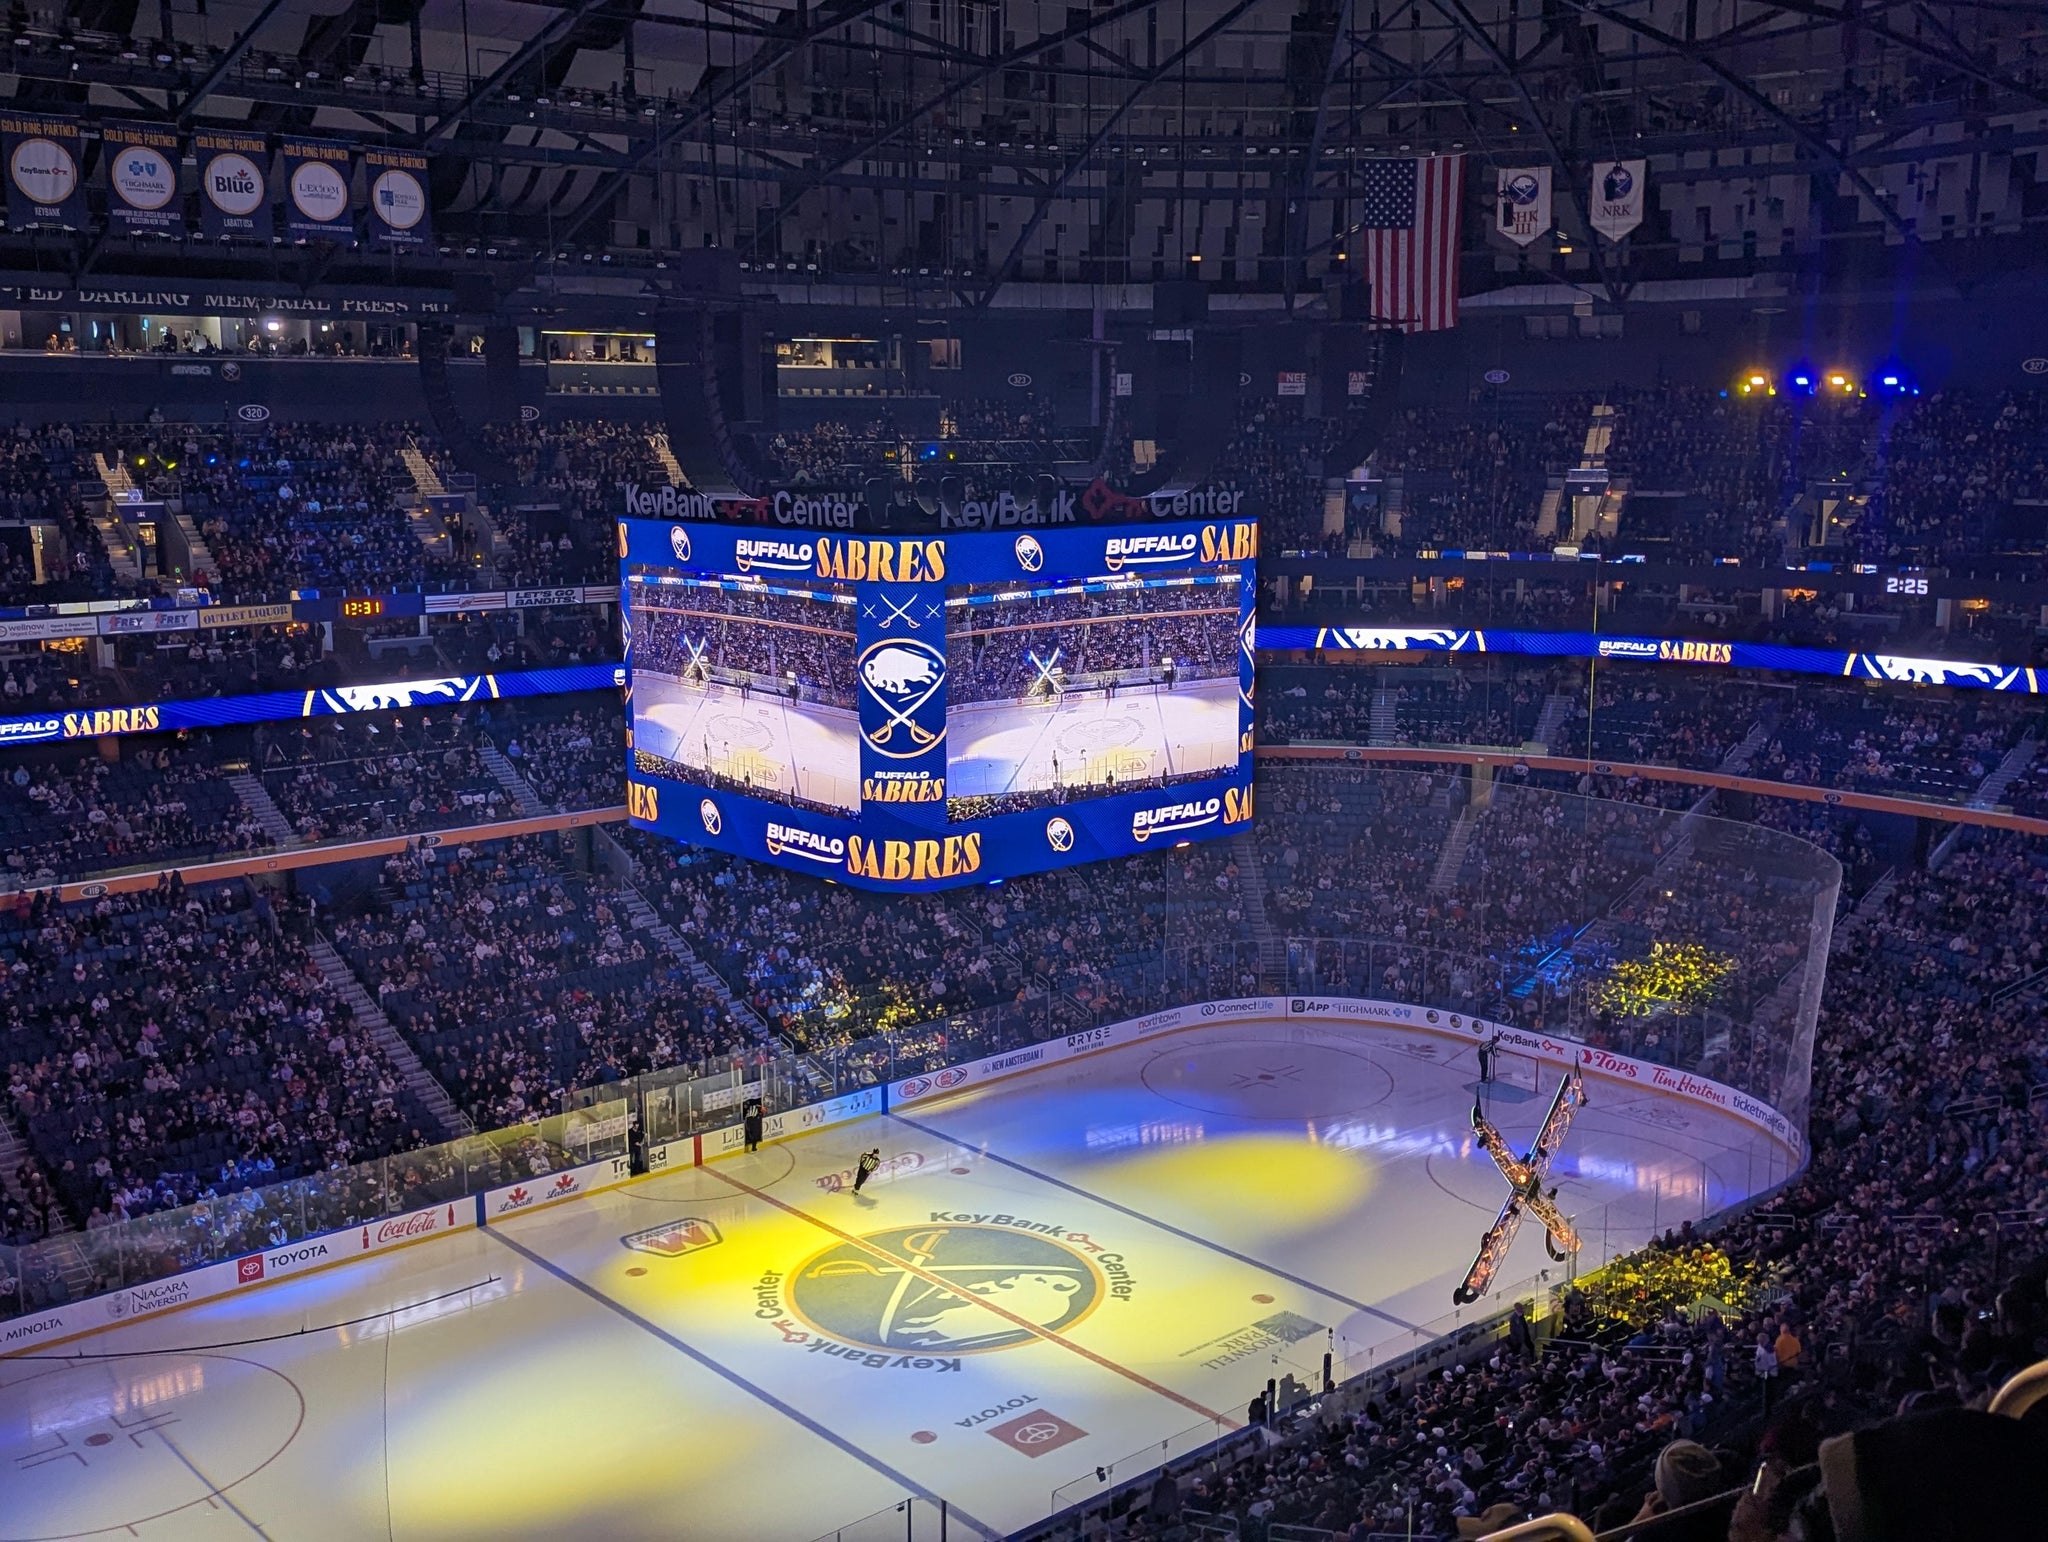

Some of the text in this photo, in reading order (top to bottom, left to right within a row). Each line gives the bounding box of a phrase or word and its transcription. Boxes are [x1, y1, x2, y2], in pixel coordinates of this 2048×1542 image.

[20, 166, 51, 175] KeyBank
[215, 175, 255, 194] Blue
[1602, 204, 1631, 217] NRK
[79, 289, 190, 307] DARLING
[342, 299, 409, 314] PRESS
[2029, 361, 2045, 371] 327
[1013, 376, 1026, 384] 323
[246, 407, 263, 419] 320
[625, 483, 860, 529] KeyBank Center
[1149, 486, 1245, 518] Center
[1105, 533, 1197, 556] BUFFALO
[736, 537, 946, 583] BUFFALO SABRES
[515, 589, 575, 599] LET'S GO
[1887, 577, 1929, 595] 2:25
[515, 595, 576, 607] BANDITS!
[115, 616, 143, 627] FREY
[160, 613, 189, 625] FREY
[203, 611, 245, 625] OUTLET
[248, 606, 288, 619] LIQUOR
[1599, 640, 1732, 664] BUFFALO SABRES
[63, 706, 159, 738] SABRES
[874, 770, 930, 781] BUFFALO
[862, 777, 946, 804] SABRES
[1132, 797, 1221, 828] BUFFALO
[766, 822, 981, 882] BUFFALO SABRES
[88, 886, 101, 895] 116
[1138, 1010, 1181, 1030] northtown
[1338, 1003, 1391, 1017] HIGHMARK
[1497, 1030, 1541, 1051] KeyBank
[1652, 1066, 1726, 1106] Tim Hortons
[546, 1183, 580, 1200] Labatt
[498, 1196, 534, 1214] Labatt
[269, 1244, 329, 1269] TOYOTA
[930, 1211, 1137, 1302] KeyBank Center
[131, 1280, 189, 1302] NIAGARA
[131, 1291, 190, 1314] UNIVERSITY
[5, 1318, 64, 1342] MINOLTA
[753, 1269, 962, 1373] KeyBank Center
[1217, 1330, 1267, 1352] PARK
[1200, 1336, 1279, 1370] ROSWELL
[954, 1395, 1039, 1428] TOYOTA
